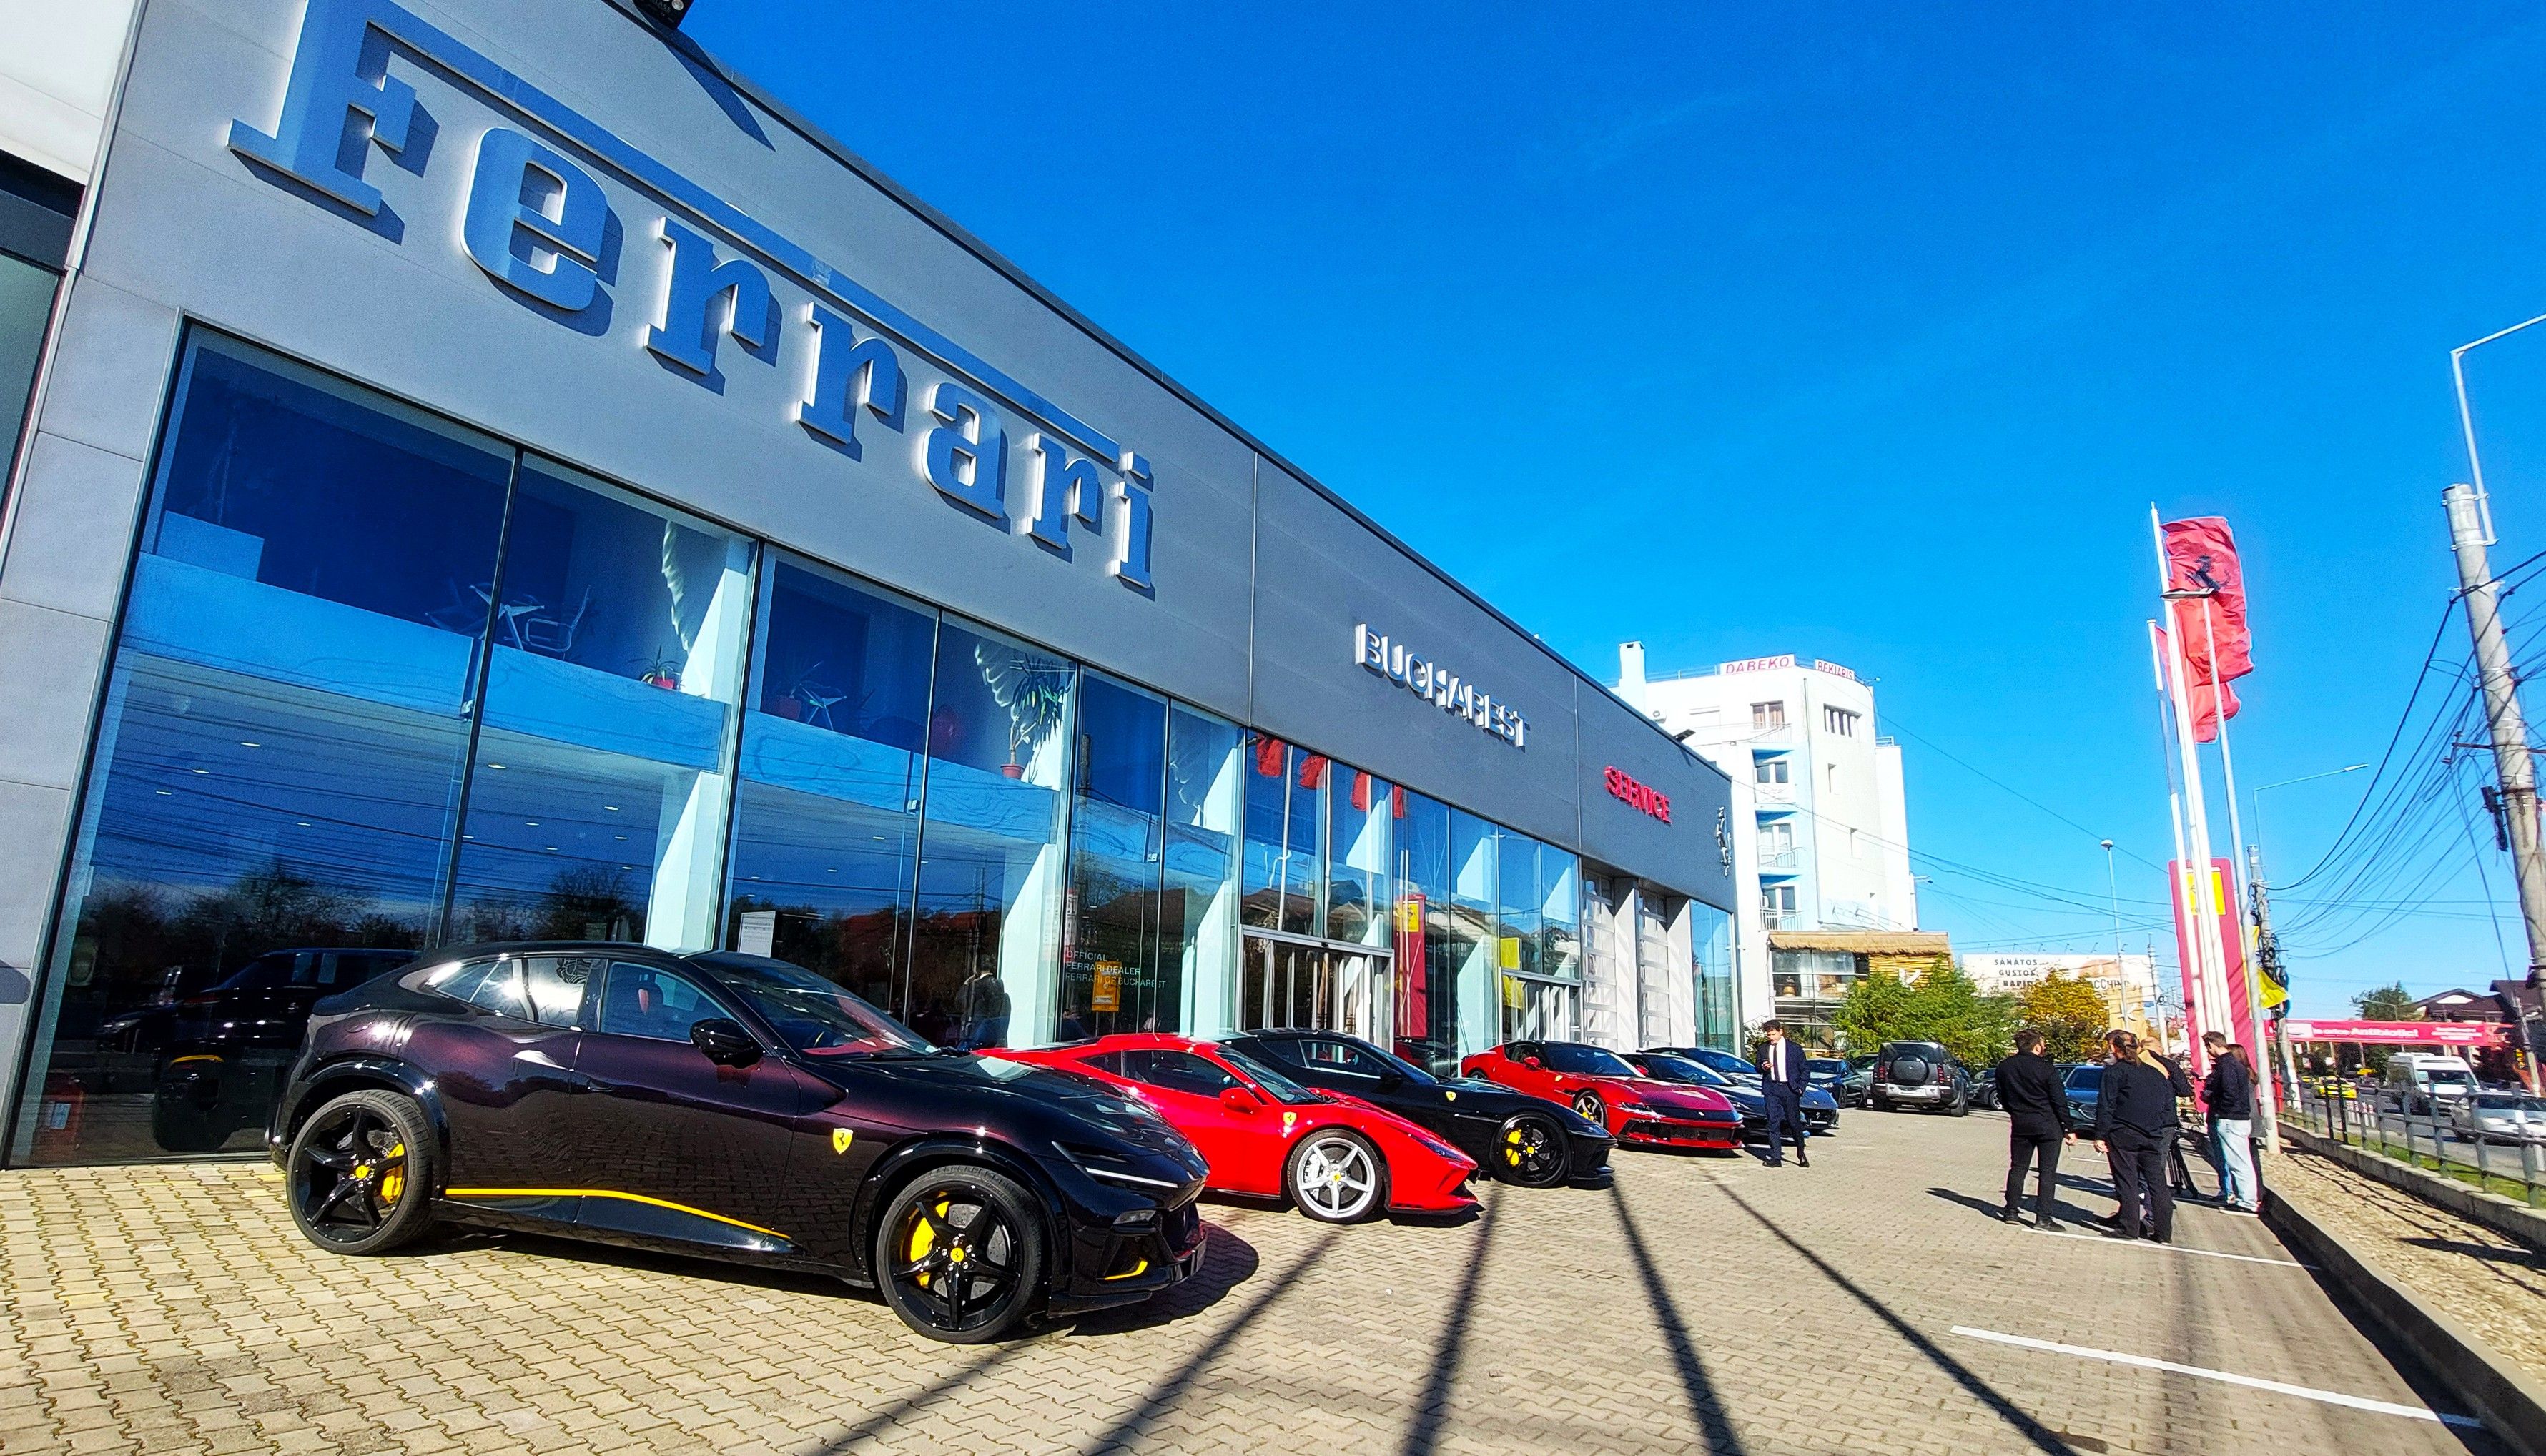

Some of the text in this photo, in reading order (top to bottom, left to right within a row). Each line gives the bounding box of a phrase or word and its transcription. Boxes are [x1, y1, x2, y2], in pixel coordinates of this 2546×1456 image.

[227, 0, 1153, 589] Ferrari
[1725, 656, 1790, 674] DABEKO
[1355, 623, 1530, 748] BUCHAREST
[1604, 766, 1673, 824] SERVICE
[1066, 950, 1108, 961] OFFICIAL
[1065, 962, 1140, 976] FERRARI DEALER
[1065, 972, 1102, 984] FERRARI
[1104, 976, 1117, 985] OF
